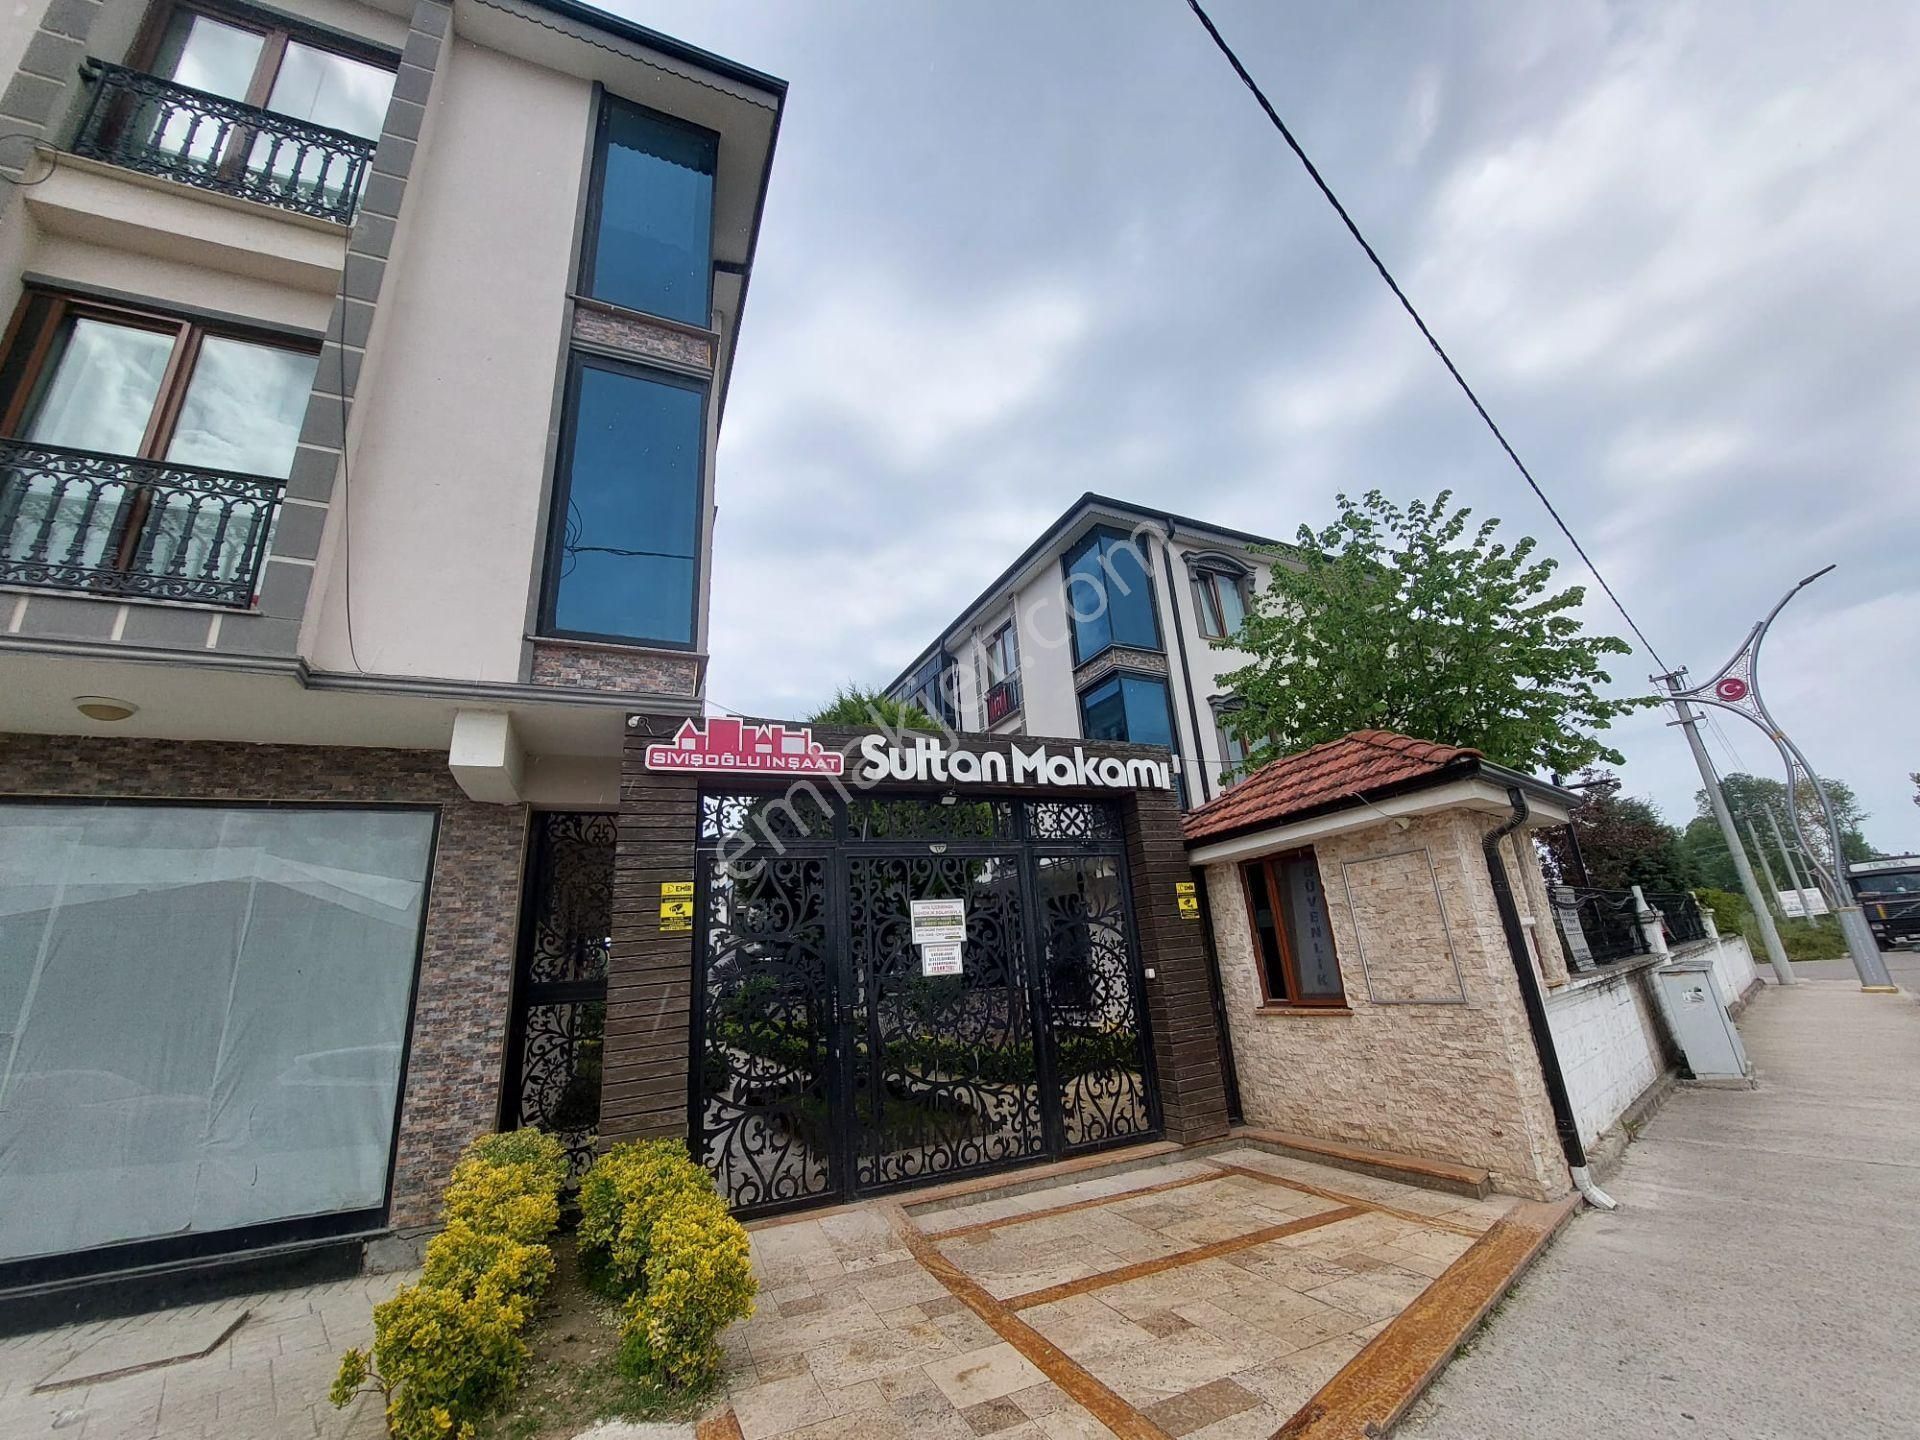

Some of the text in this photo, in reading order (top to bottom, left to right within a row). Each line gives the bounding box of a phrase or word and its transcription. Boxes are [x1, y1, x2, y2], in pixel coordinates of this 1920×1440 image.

[652, 751, 839, 770] SİVİŞOĞLU İNŞAAT
[861, 734, 1171, 790] Sultan Makamı
